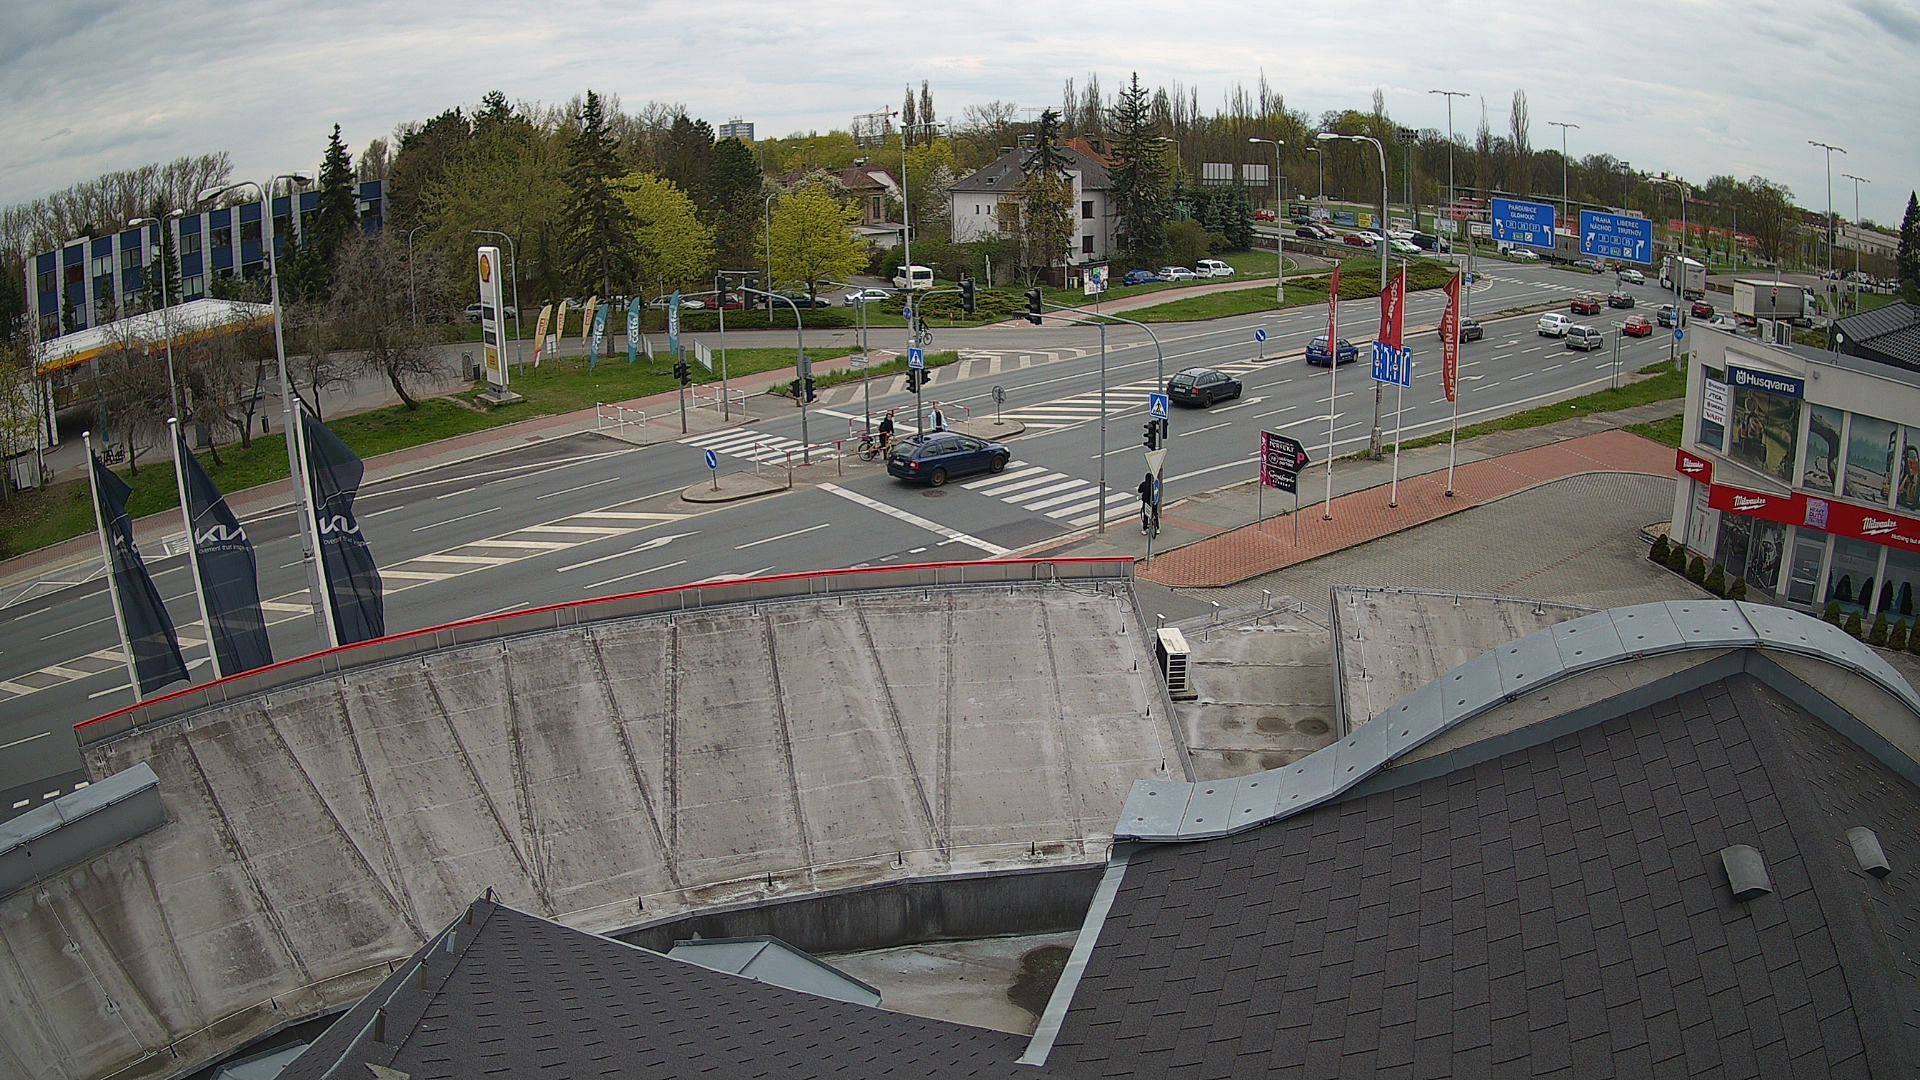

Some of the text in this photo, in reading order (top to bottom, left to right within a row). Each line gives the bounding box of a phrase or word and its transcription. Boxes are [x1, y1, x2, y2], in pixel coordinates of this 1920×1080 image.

[1508, 203, 1537, 214] PARDUBICE
[1510, 212, 1535, 221] OLOMOUC
[1592, 215, 1639, 229] PRAHA LIBEREC
[1589, 222, 1642, 237] NÁCHOD TRUTNOV
[1746, 373, 1795, 393] Husqvarna
[1705, 411, 1723, 422] VARI
[1733, 495, 1767, 507] Milwaukee
[1861, 516, 1897, 531] Milwaukee
[195, 524, 247, 545] KIA
